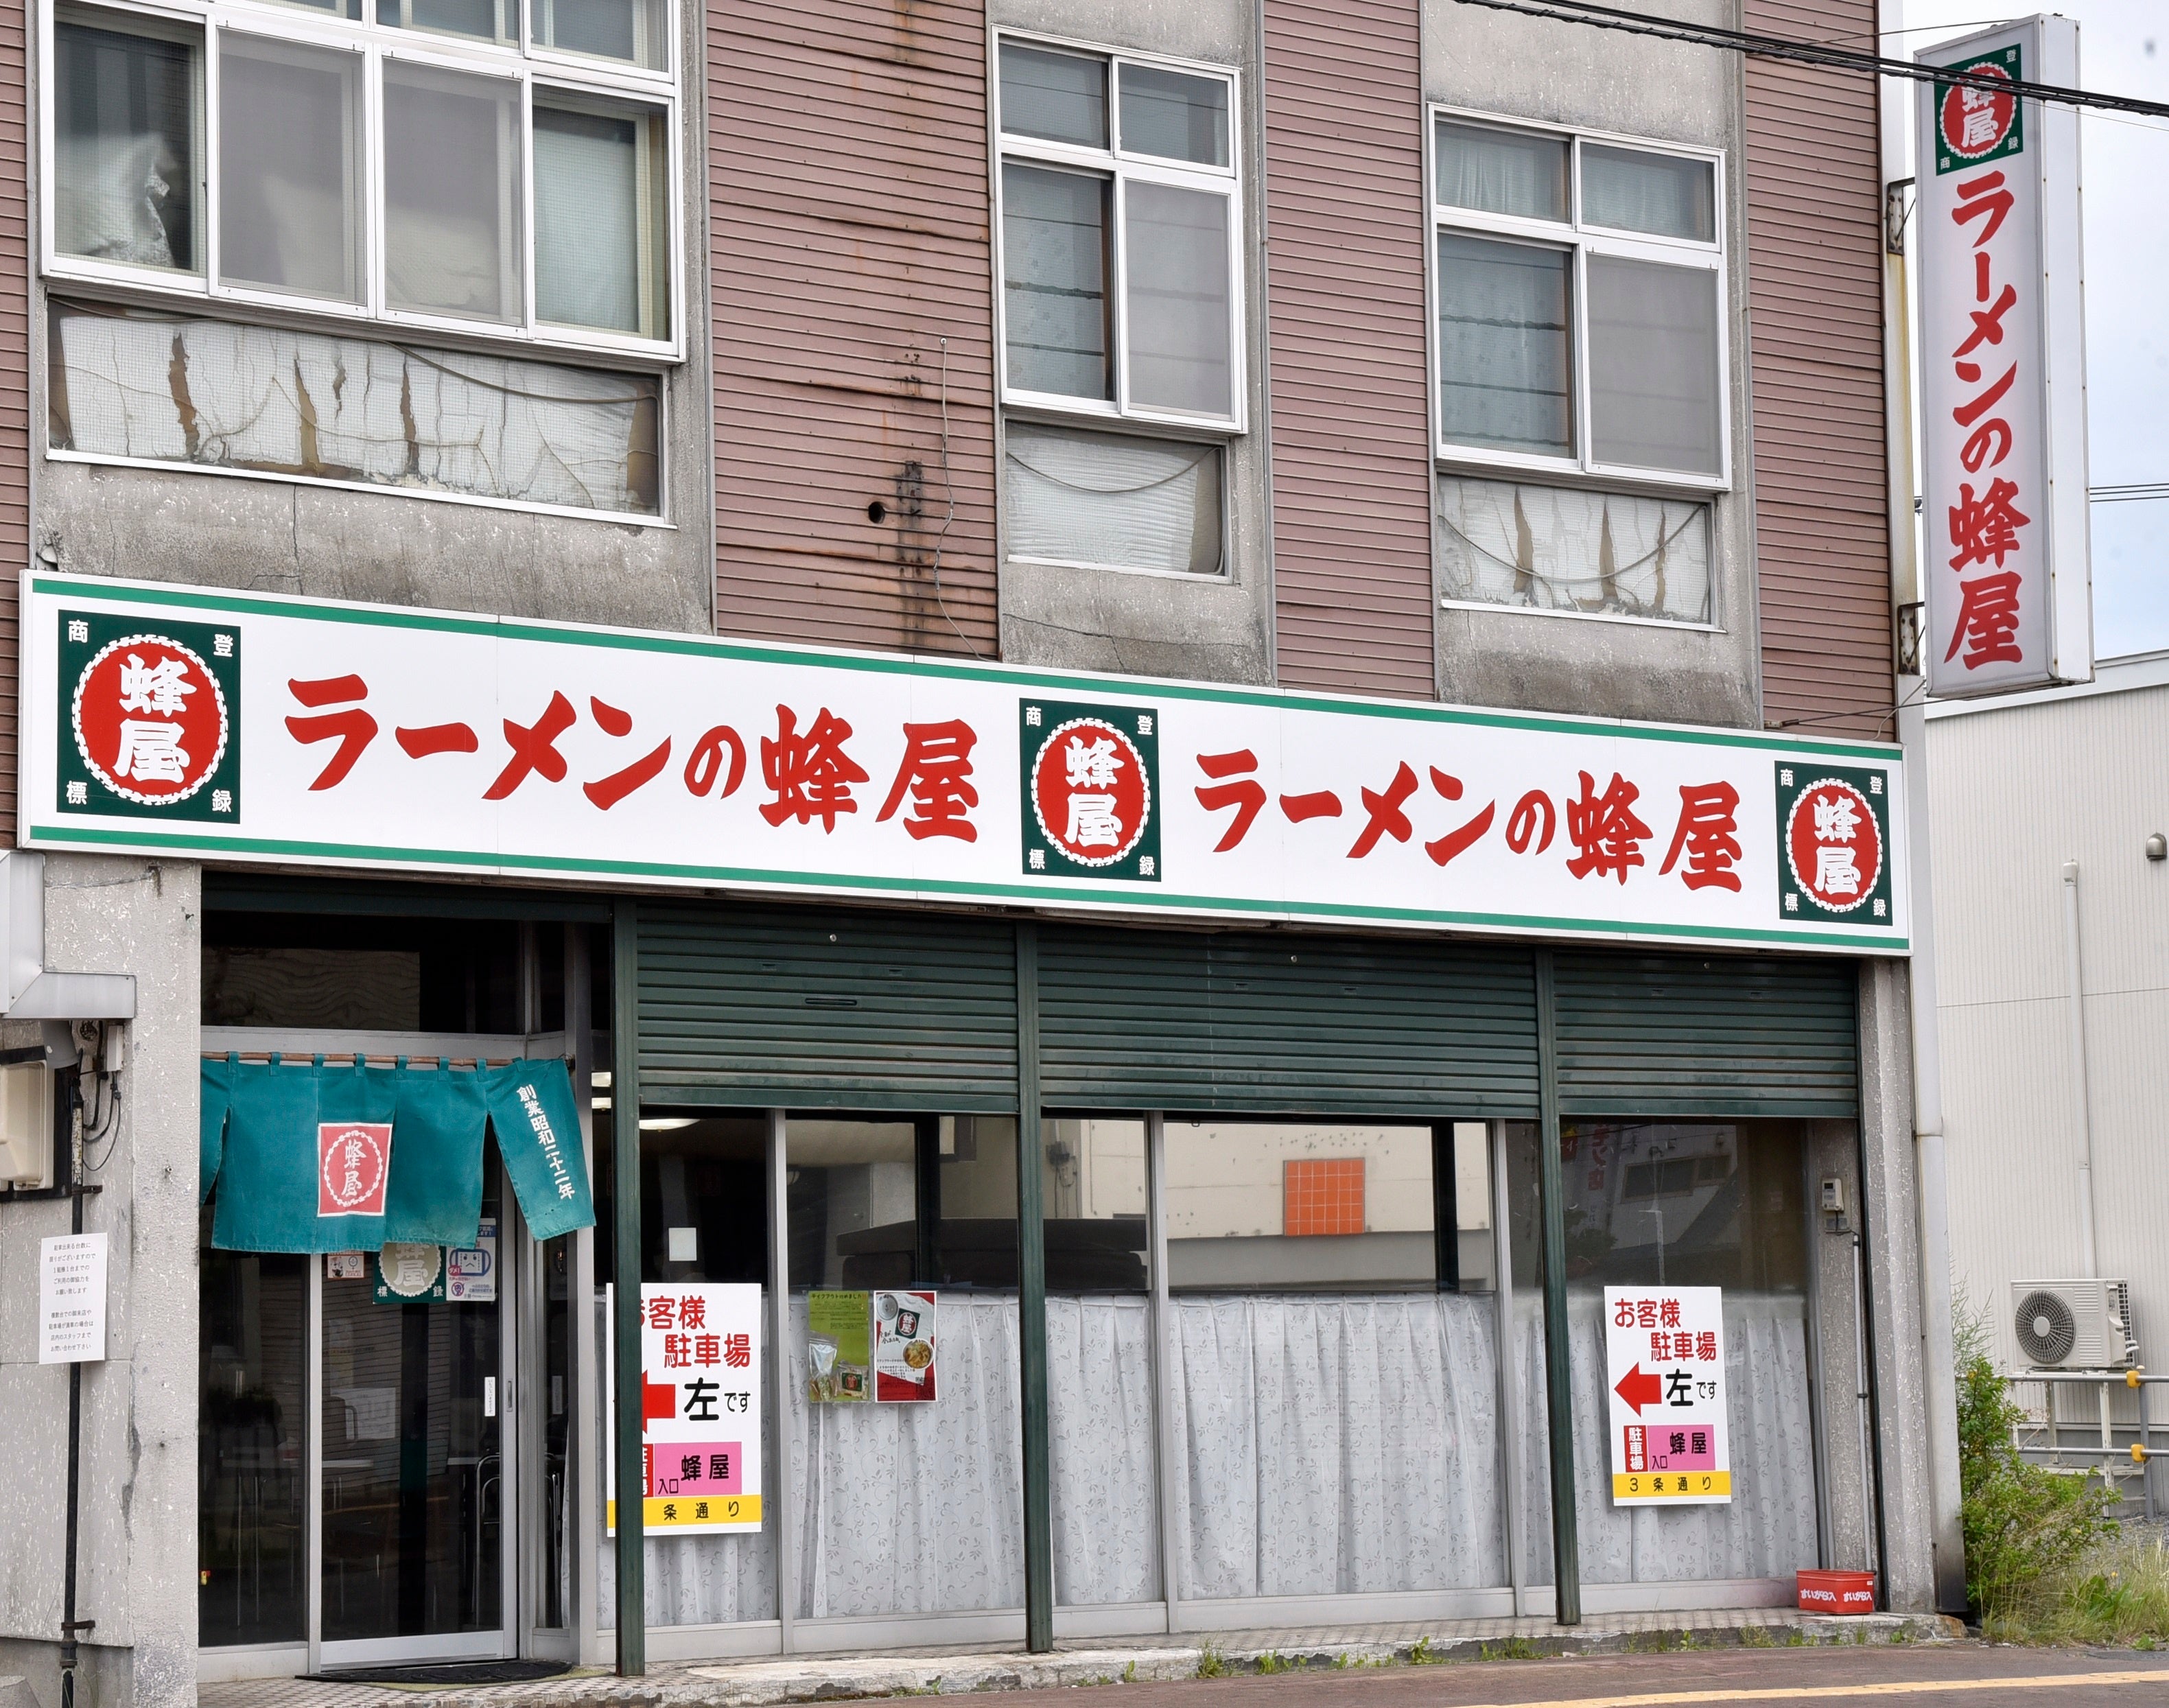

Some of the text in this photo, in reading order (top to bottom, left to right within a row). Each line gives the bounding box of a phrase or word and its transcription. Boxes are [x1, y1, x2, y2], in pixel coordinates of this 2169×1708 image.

[2006, 49, 2016, 63] 登
[1940, 156, 1950, 170] 商
[1944, 169, 2030, 670] ラーメンの蜂屋
[69, 619, 89, 643] 商
[213, 633, 233, 657] 登
[114, 653, 197, 783] 蜂屋
[1026, 705, 1042, 727] 商
[1137, 715, 1153, 736] 登
[285, 674, 979, 843] ラーメンの蜂屋
[1780, 768, 1794, 787] 商
[1870, 775, 1883, 795] 登
[67, 780, 88, 805] 標
[212, 788, 232, 812] 録
[1065, 736, 1125, 847] 蜂屋
[1195, 749, 1742, 892] ラーメンの蜂屋
[1812, 794, 1862, 894] 蜂屋
[1029, 848, 1045, 869] 標
[1139, 855, 1155, 876] 録
[1784, 892, 1798, 912] 標
[1873, 898, 1886, 917] 録
[516, 1084, 576, 1200] 創業昭和二十二年
[342, 1138, 366, 1197] 蜂屋
[642, 1296, 705, 1329] 客様
[1615, 1298, 1680, 1328] お客様
[665, 1333, 751, 1368] 駐車場
[1651, 1331, 1716, 1361] 駐車場
[683, 1377, 751, 1421] 左です
[1666, 1368, 1717, 1407] 左です
[1628, 1427, 1644, 1471] 駐車場
[1669, 1431, 1707, 1455] 蜂屋
[681, 1453, 729, 1482] 蜂屋
[1652, 1455, 1668, 1470] 入口
[658, 1478, 679, 1495] 入口
[1630, 1476, 1711, 1493] 3条通り
